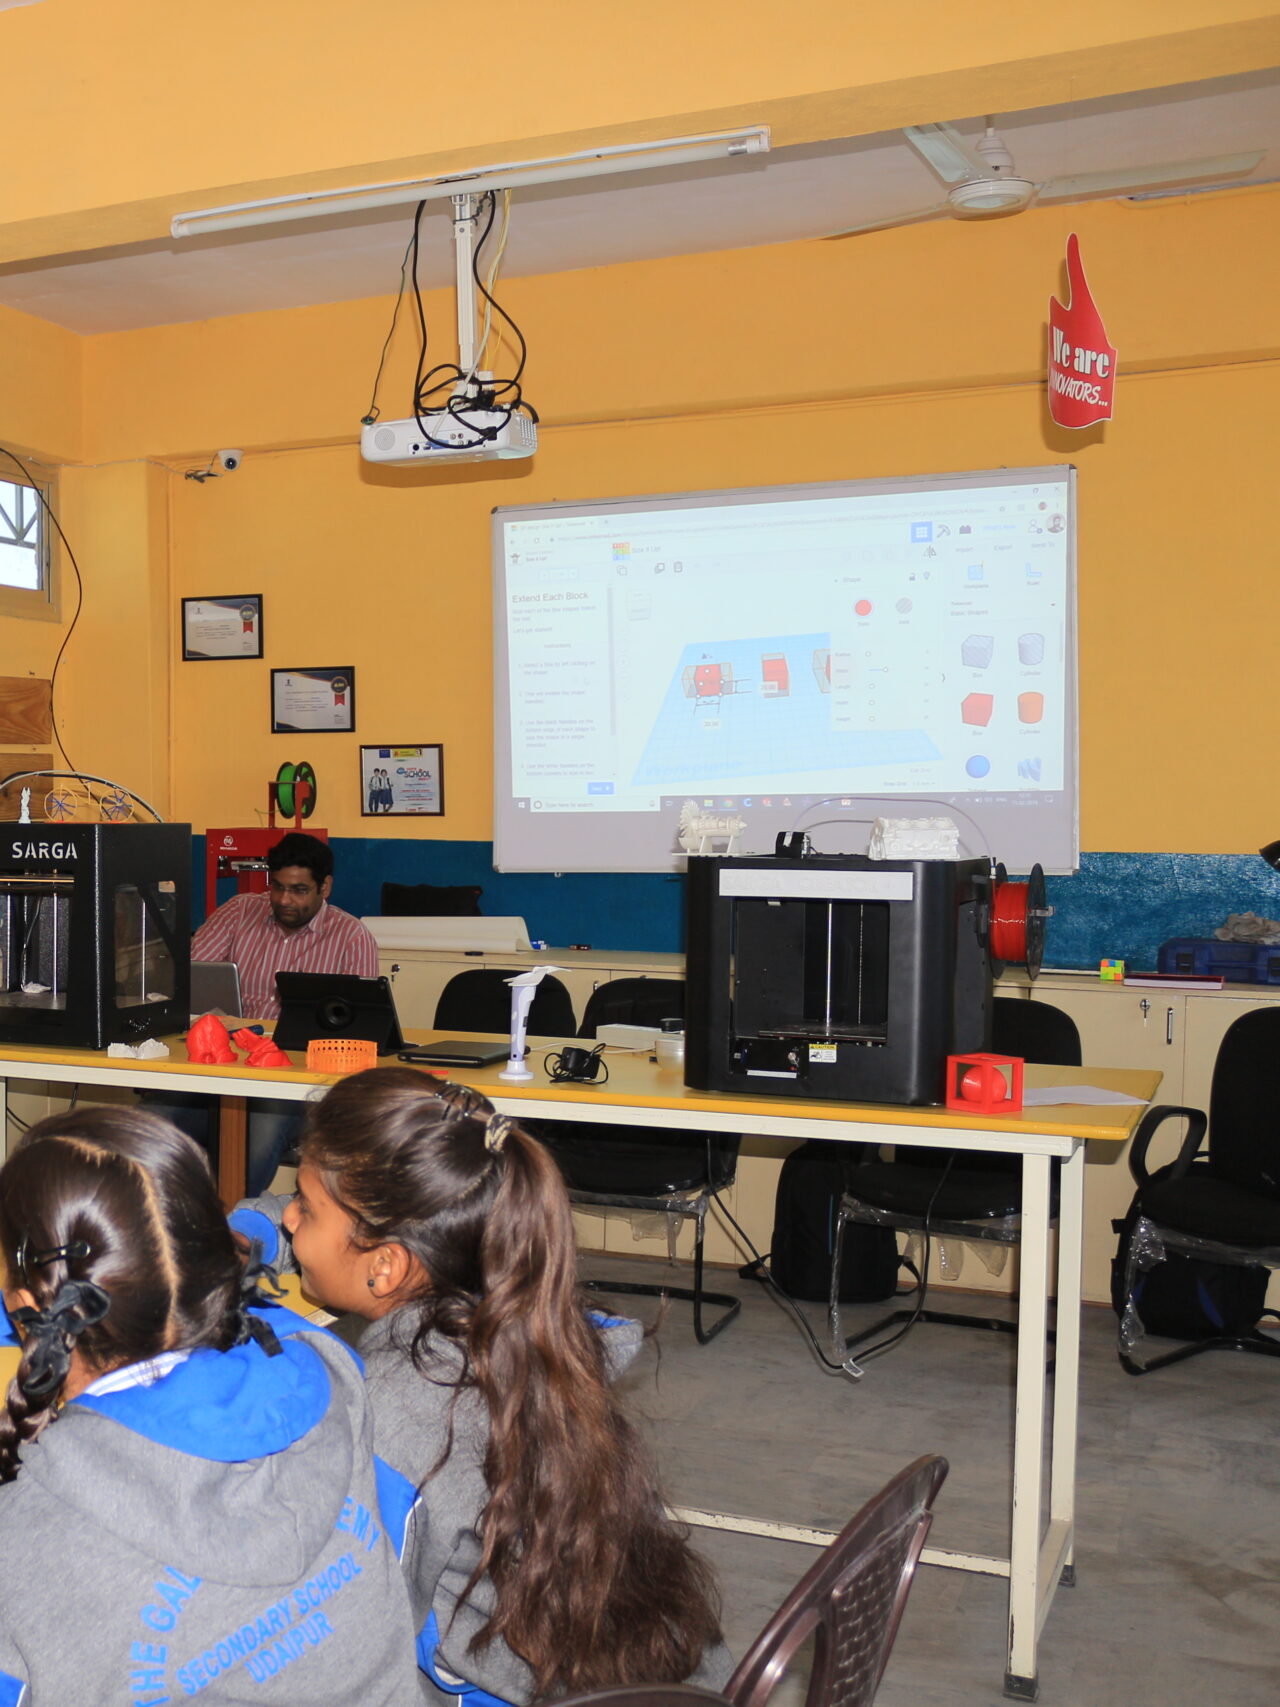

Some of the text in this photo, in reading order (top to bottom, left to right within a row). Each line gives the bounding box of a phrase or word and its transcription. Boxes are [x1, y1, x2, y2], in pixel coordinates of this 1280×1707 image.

[1052, 325, 1110, 378] We are
[512, 591, 589, 603] Extend Each Block
[12, 842, 78, 859] SARGA
[176, 1552, 364, 1695] SECONDARY SCHOOL
[244, 1611, 335, 1684] UDAIPUR
